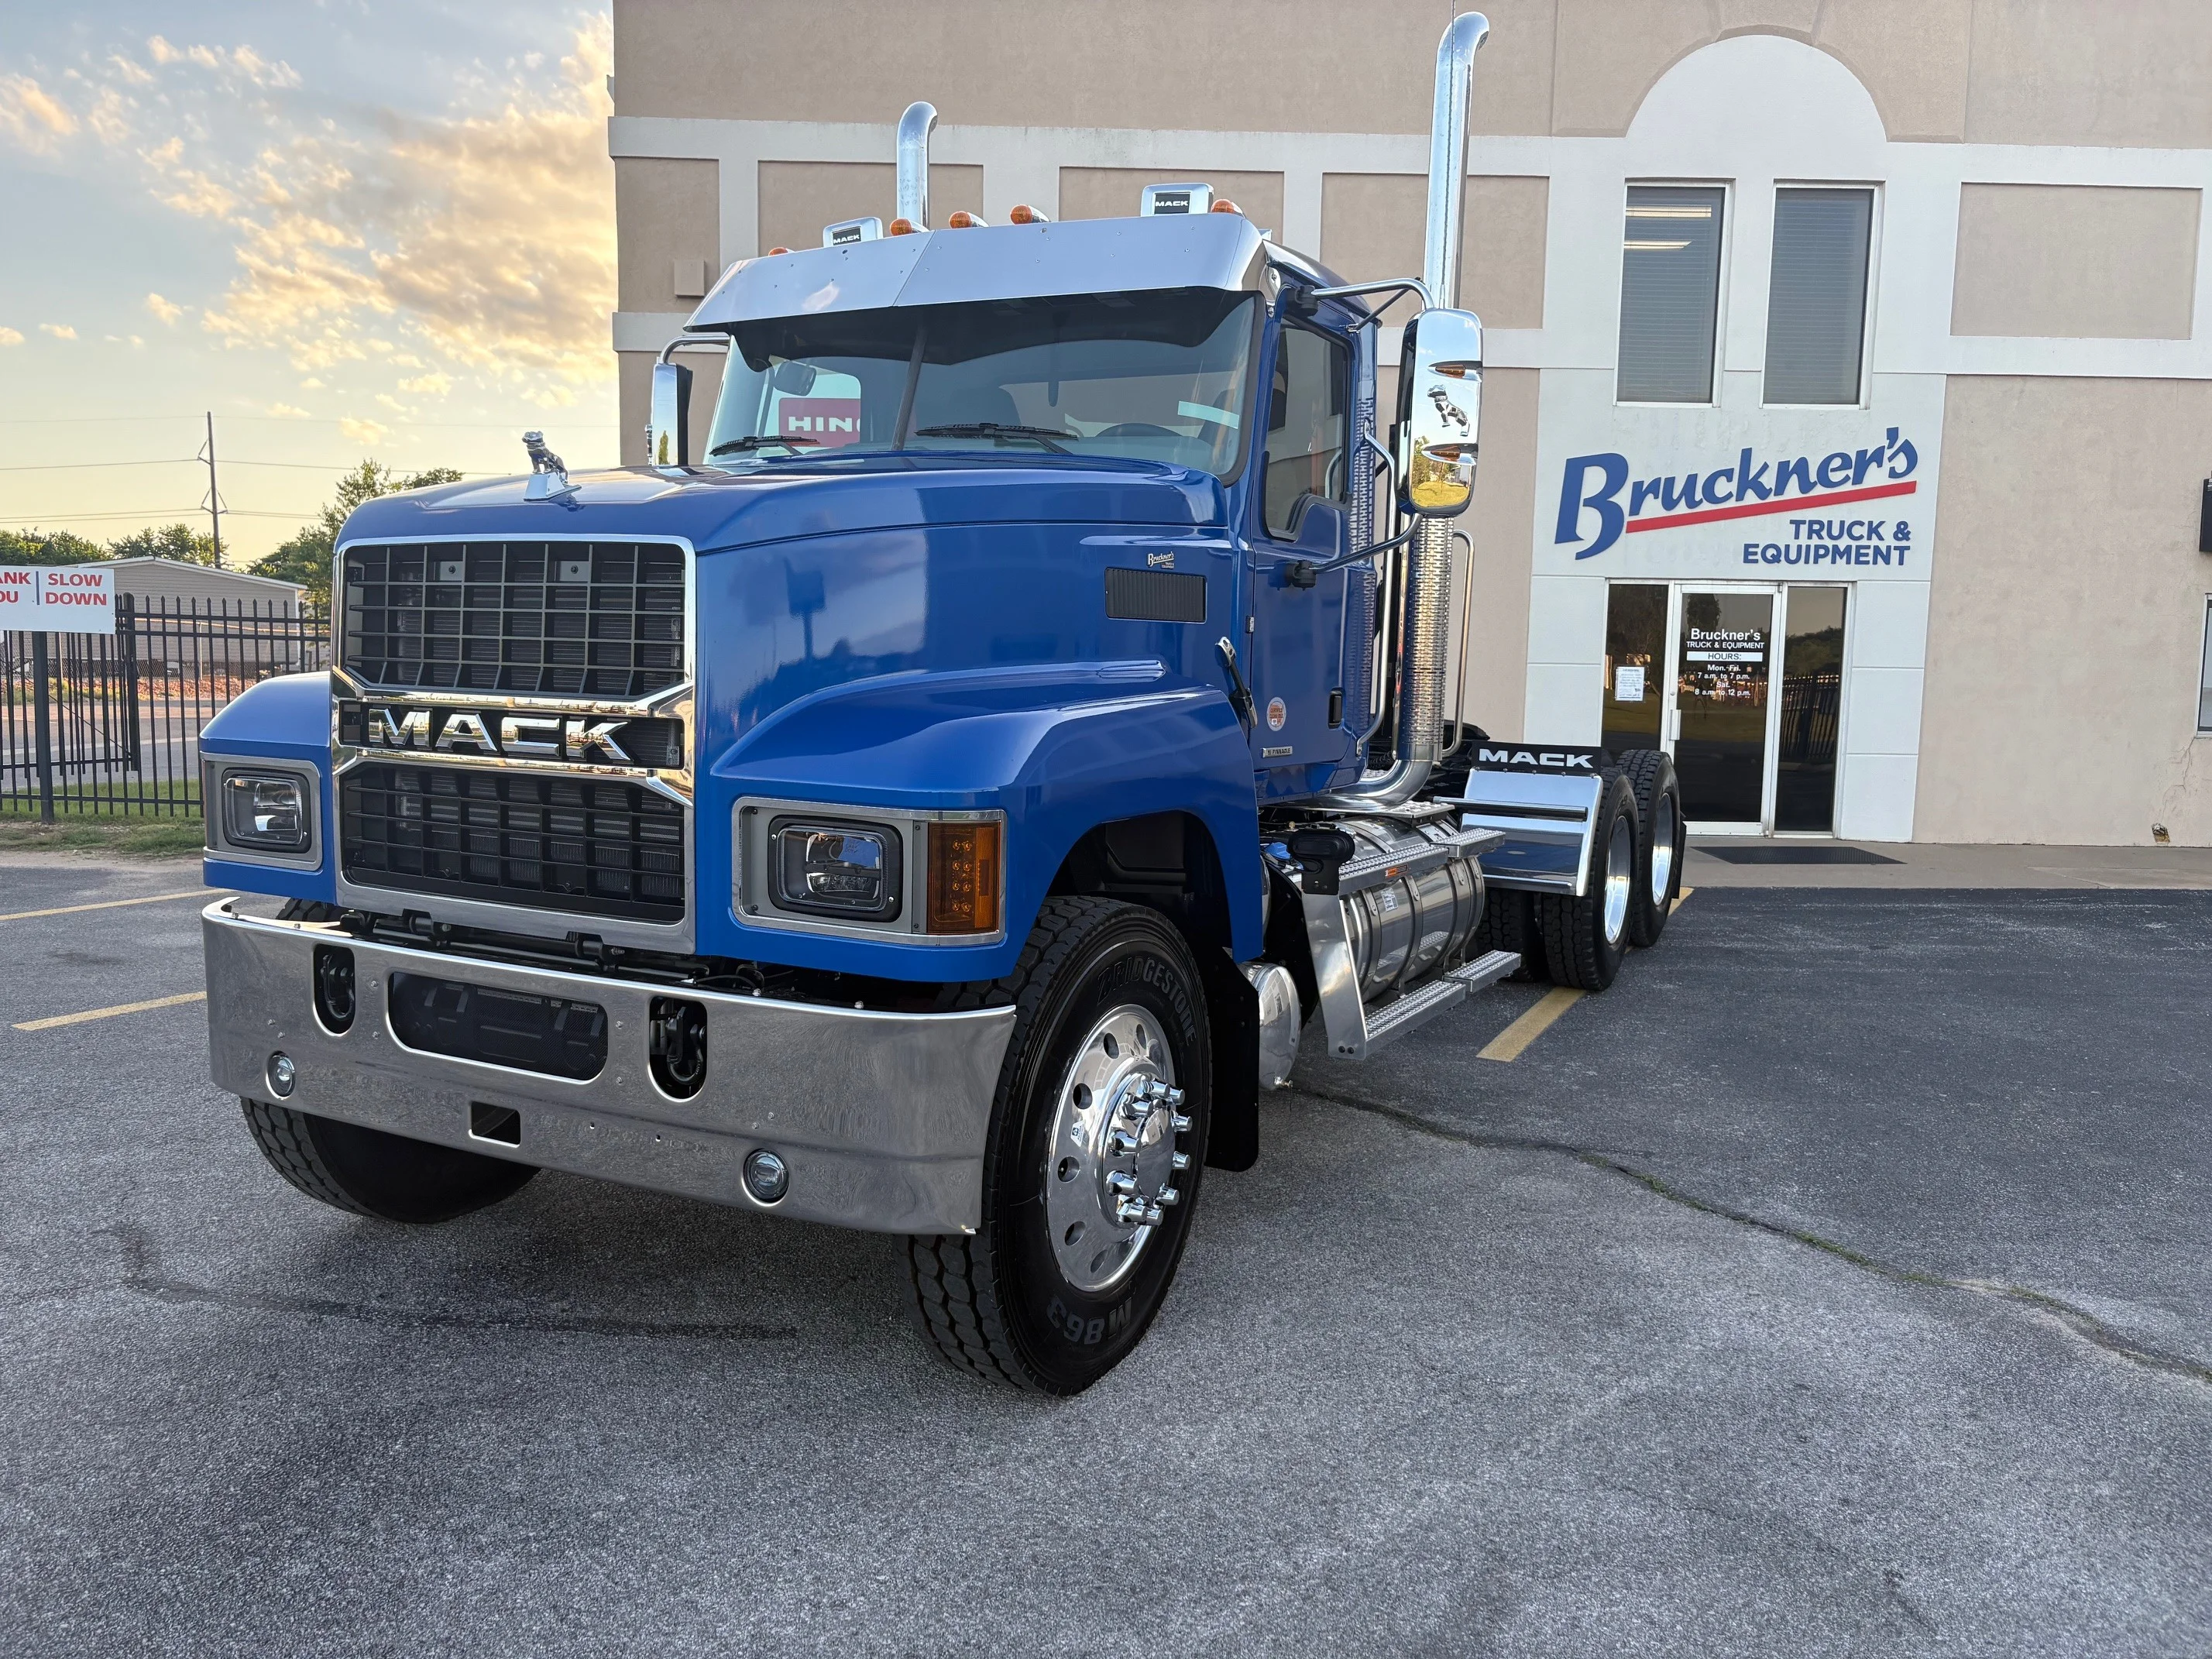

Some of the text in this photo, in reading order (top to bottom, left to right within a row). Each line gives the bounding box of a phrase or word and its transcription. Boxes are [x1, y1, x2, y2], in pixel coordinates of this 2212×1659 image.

[833, 234, 860, 245] MACK
[788, 416, 860, 432] HIN
[1554, 427, 1918, 560] Bruckner's
[1790, 519, 1911, 541] TRUCK &
[1743, 544, 1911, 565] EQUIPMENT
[48, 573, 102, 586] SLOW
[45, 592, 107, 606] DOWN
[1691, 628, 1761, 641] Bruckner's
[368, 708, 634, 762] MACK
[1479, 748, 1594, 769] MACK
[1097, 956, 1197, 1046] BRIDGESTONE
